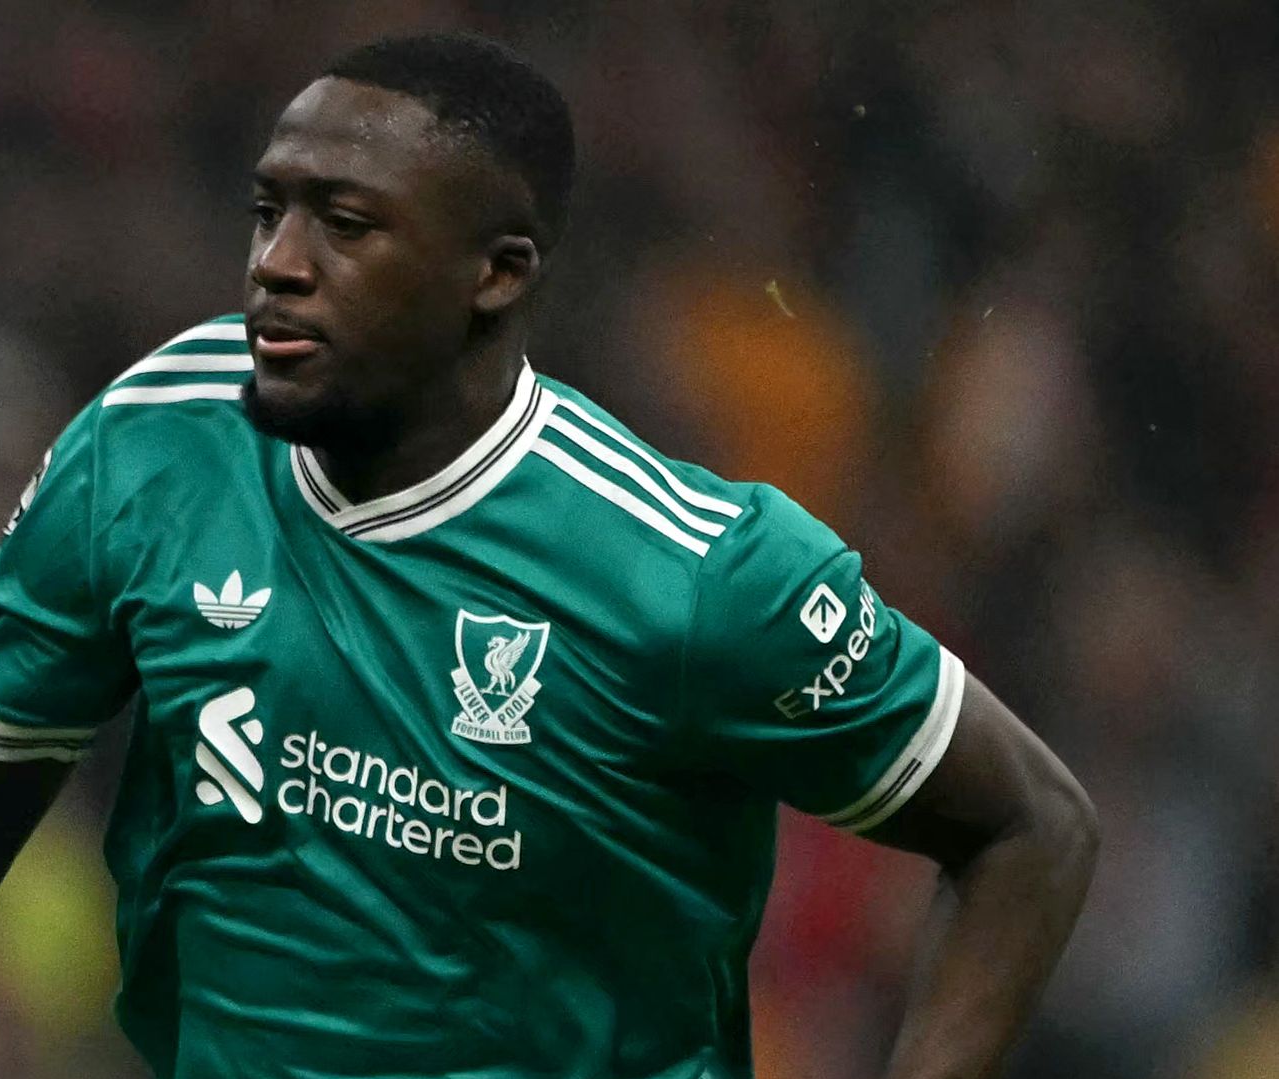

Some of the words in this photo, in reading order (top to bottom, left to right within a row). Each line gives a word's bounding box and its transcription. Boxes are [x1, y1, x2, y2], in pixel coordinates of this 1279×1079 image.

[455, 721, 501, 741] FOOTBALL
[504, 729, 528, 741] CLUB
[460, 686, 490, 725] LIVER
[497, 694, 530, 726] POOL
[280, 730, 507, 827] standard
[277, 775, 522, 871] chartered
